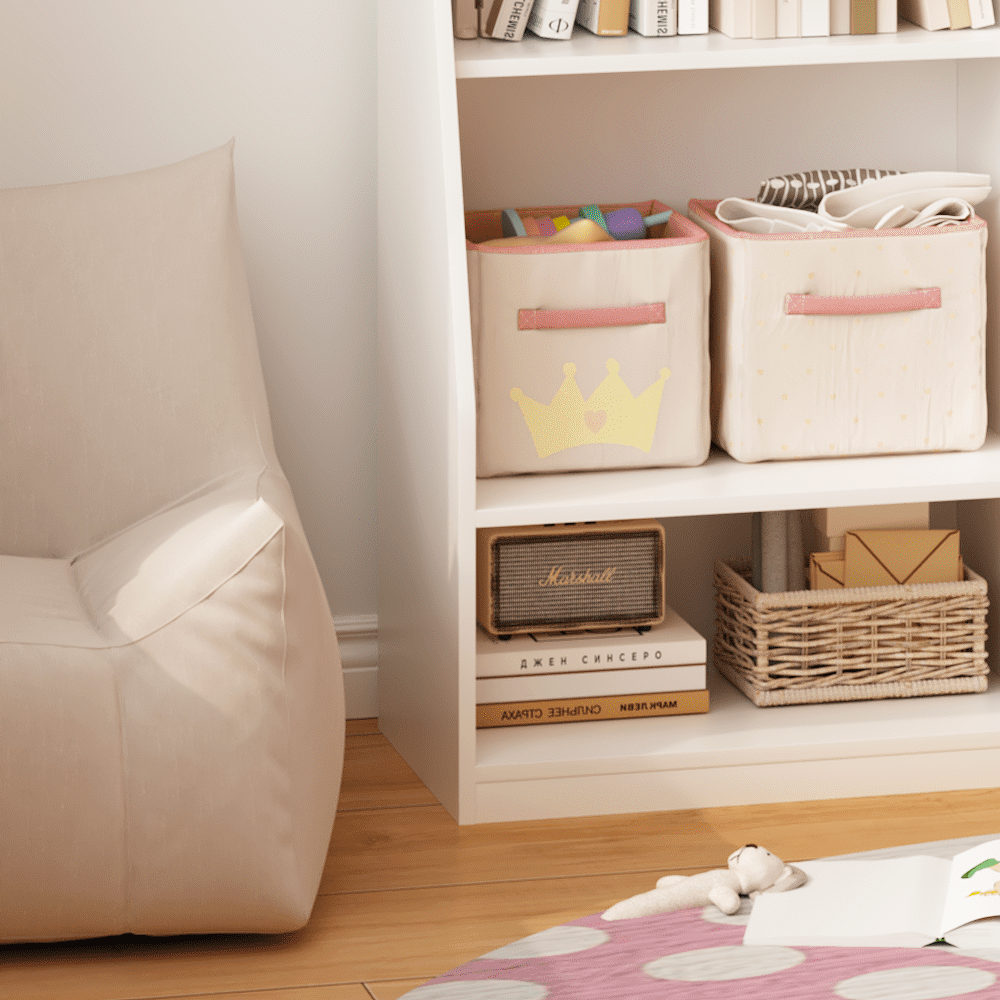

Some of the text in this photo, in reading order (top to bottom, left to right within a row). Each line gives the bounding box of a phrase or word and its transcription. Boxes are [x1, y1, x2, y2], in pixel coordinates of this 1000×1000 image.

[538, 566, 617, 587] Marshall
[520, 650, 662, 669] ДЖЕН СИНСЕРО
